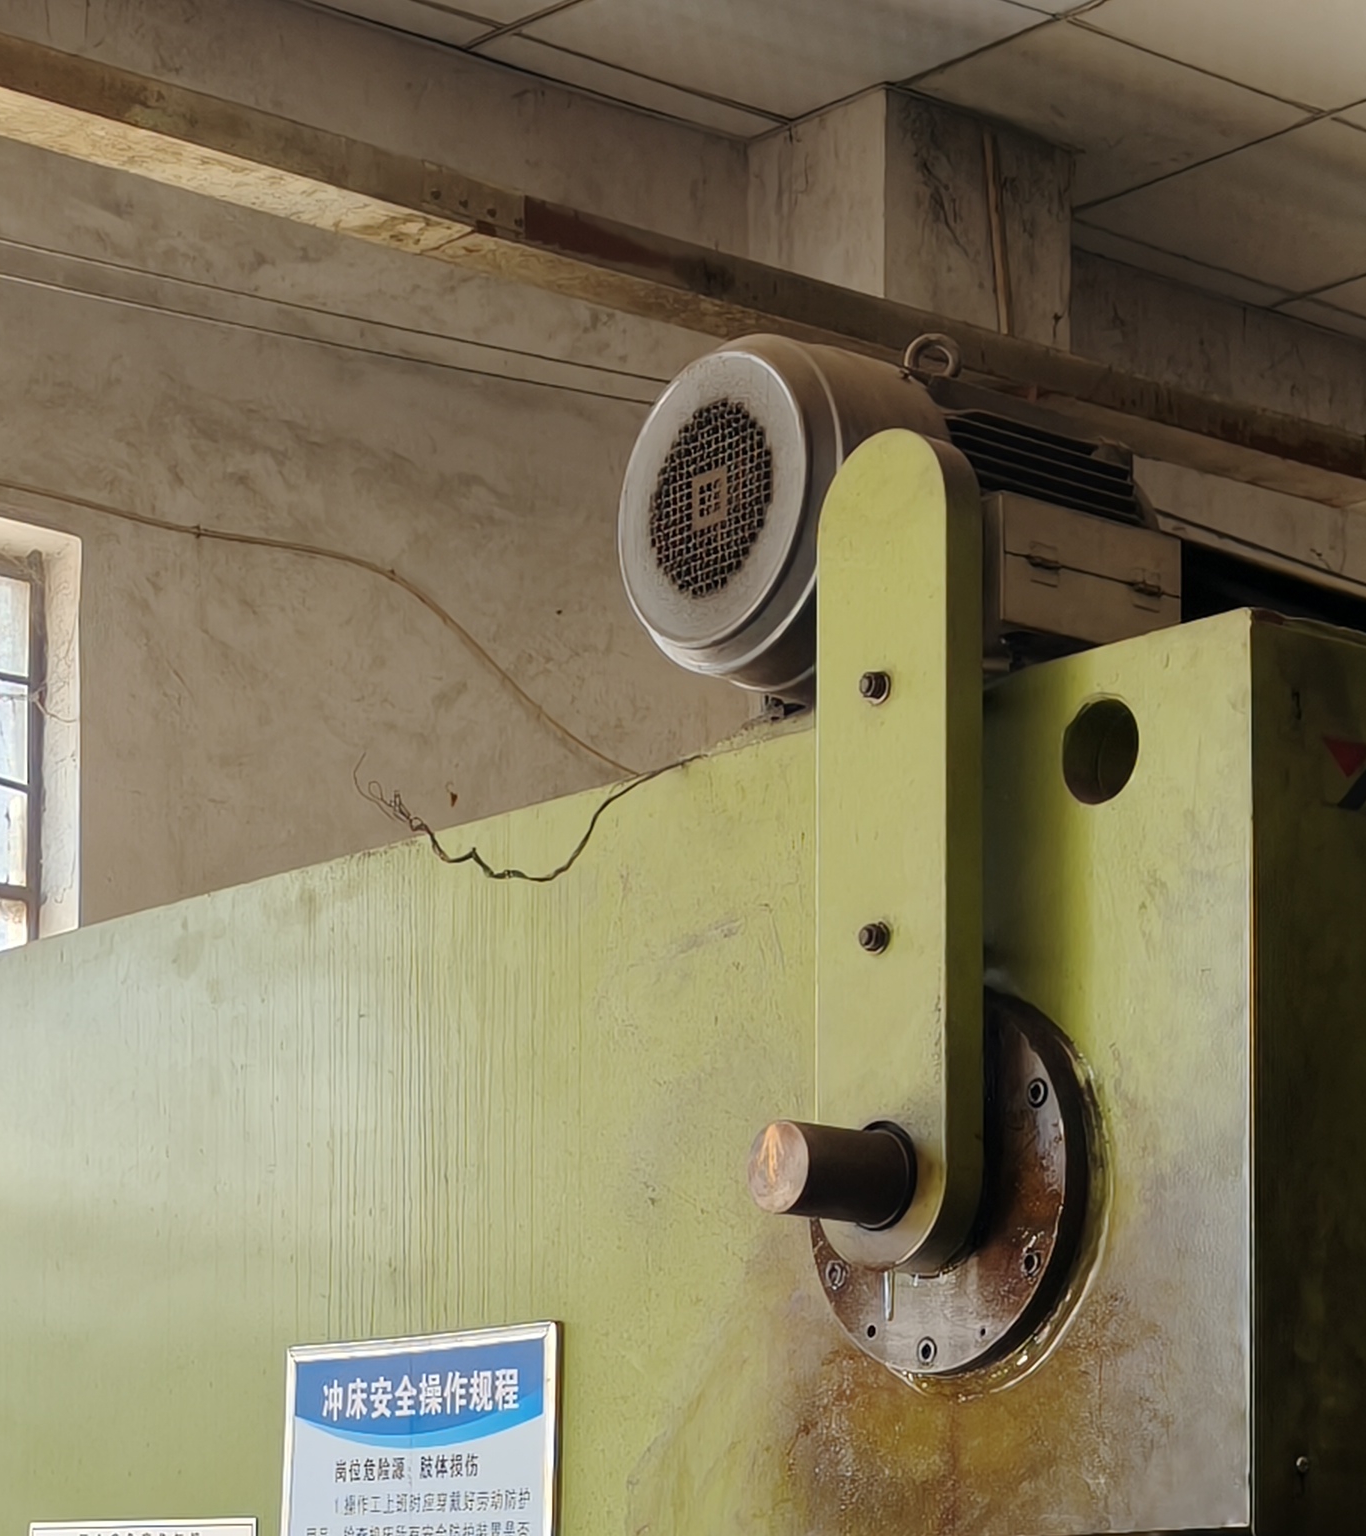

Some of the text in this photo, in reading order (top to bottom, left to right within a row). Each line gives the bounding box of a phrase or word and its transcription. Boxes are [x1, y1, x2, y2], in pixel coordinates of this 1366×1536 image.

[322, 1368, 520, 1421] 冲床安全操作规程
